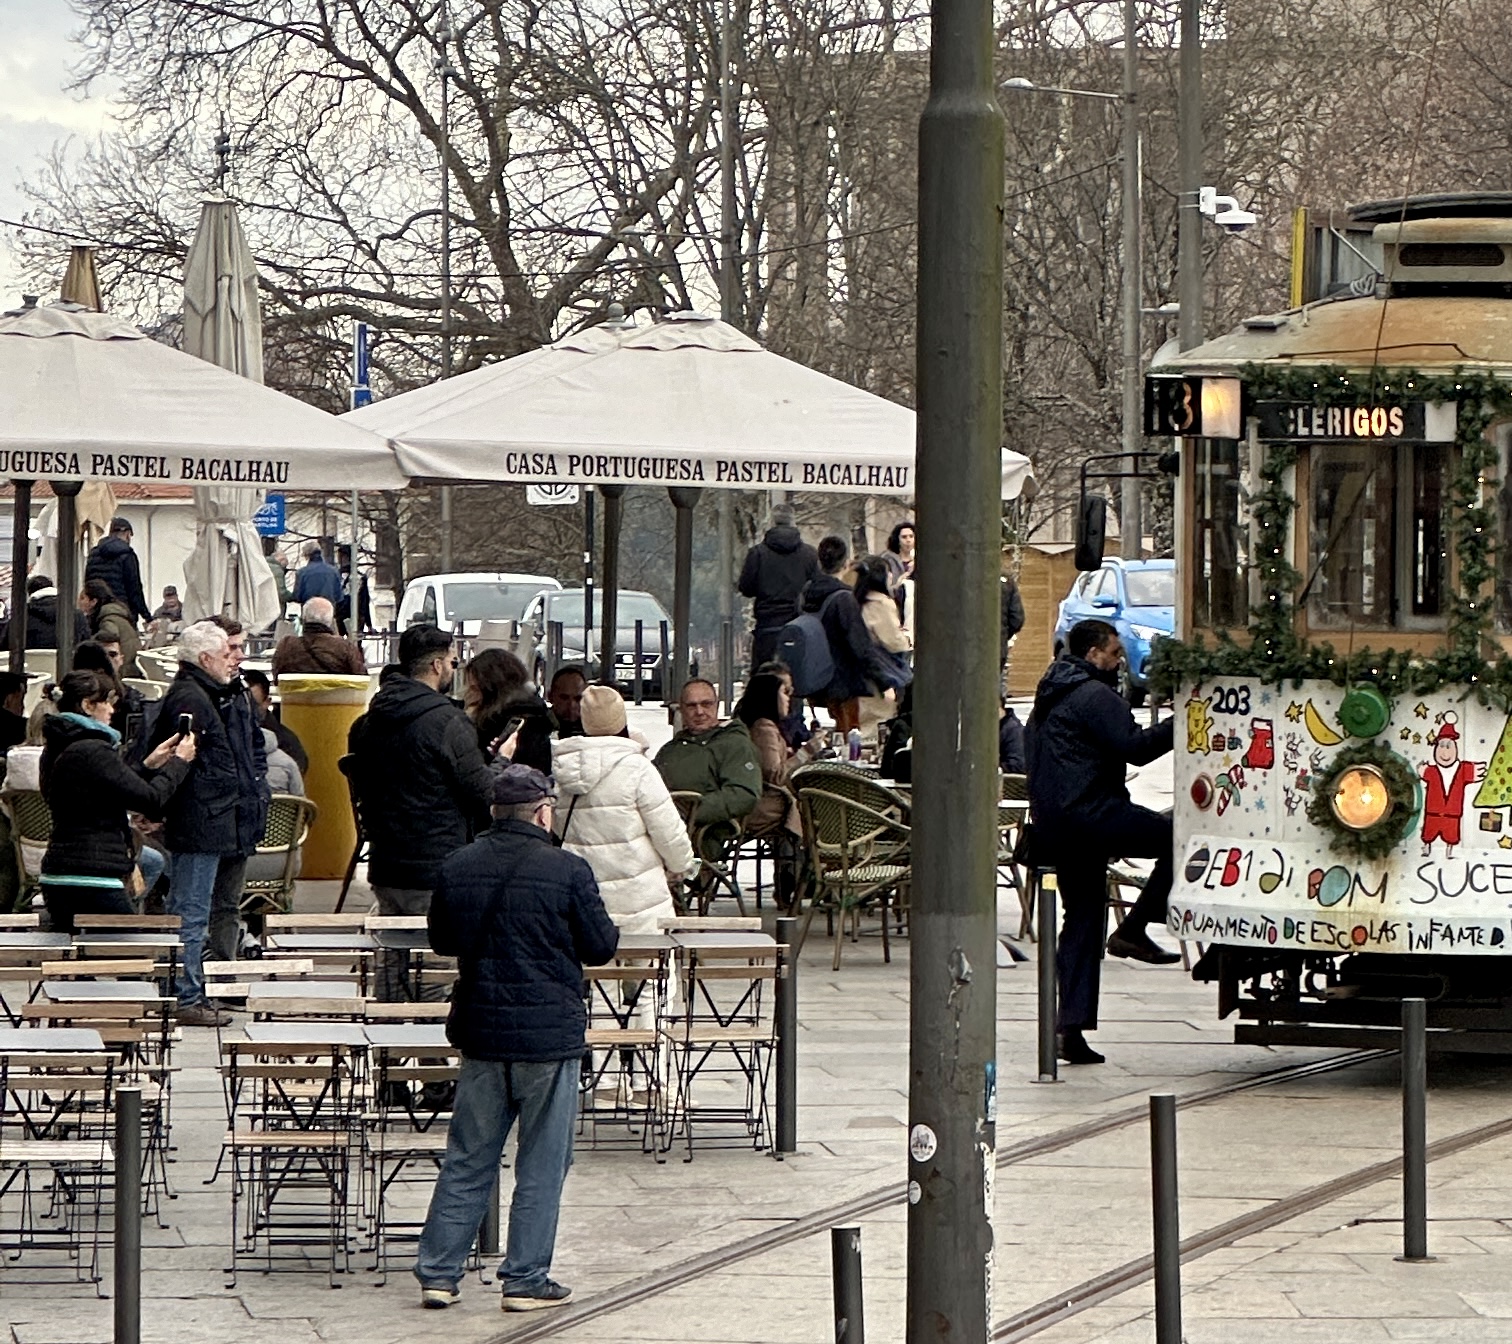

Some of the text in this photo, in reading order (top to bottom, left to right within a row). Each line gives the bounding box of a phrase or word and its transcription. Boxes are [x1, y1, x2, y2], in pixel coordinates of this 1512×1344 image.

[0, 450, 289, 483] UGUESA PASTEL BACALHAU
[506, 452, 908, 488] CASA PORTUGUESA PASTEL BACALHAU
[1212, 685, 1251, 716] 203
[1307, 865, 1389, 908] BOM
[1283, 917, 1306, 945] DE
[1311, 920, 1401, 950] ESCOLAS
